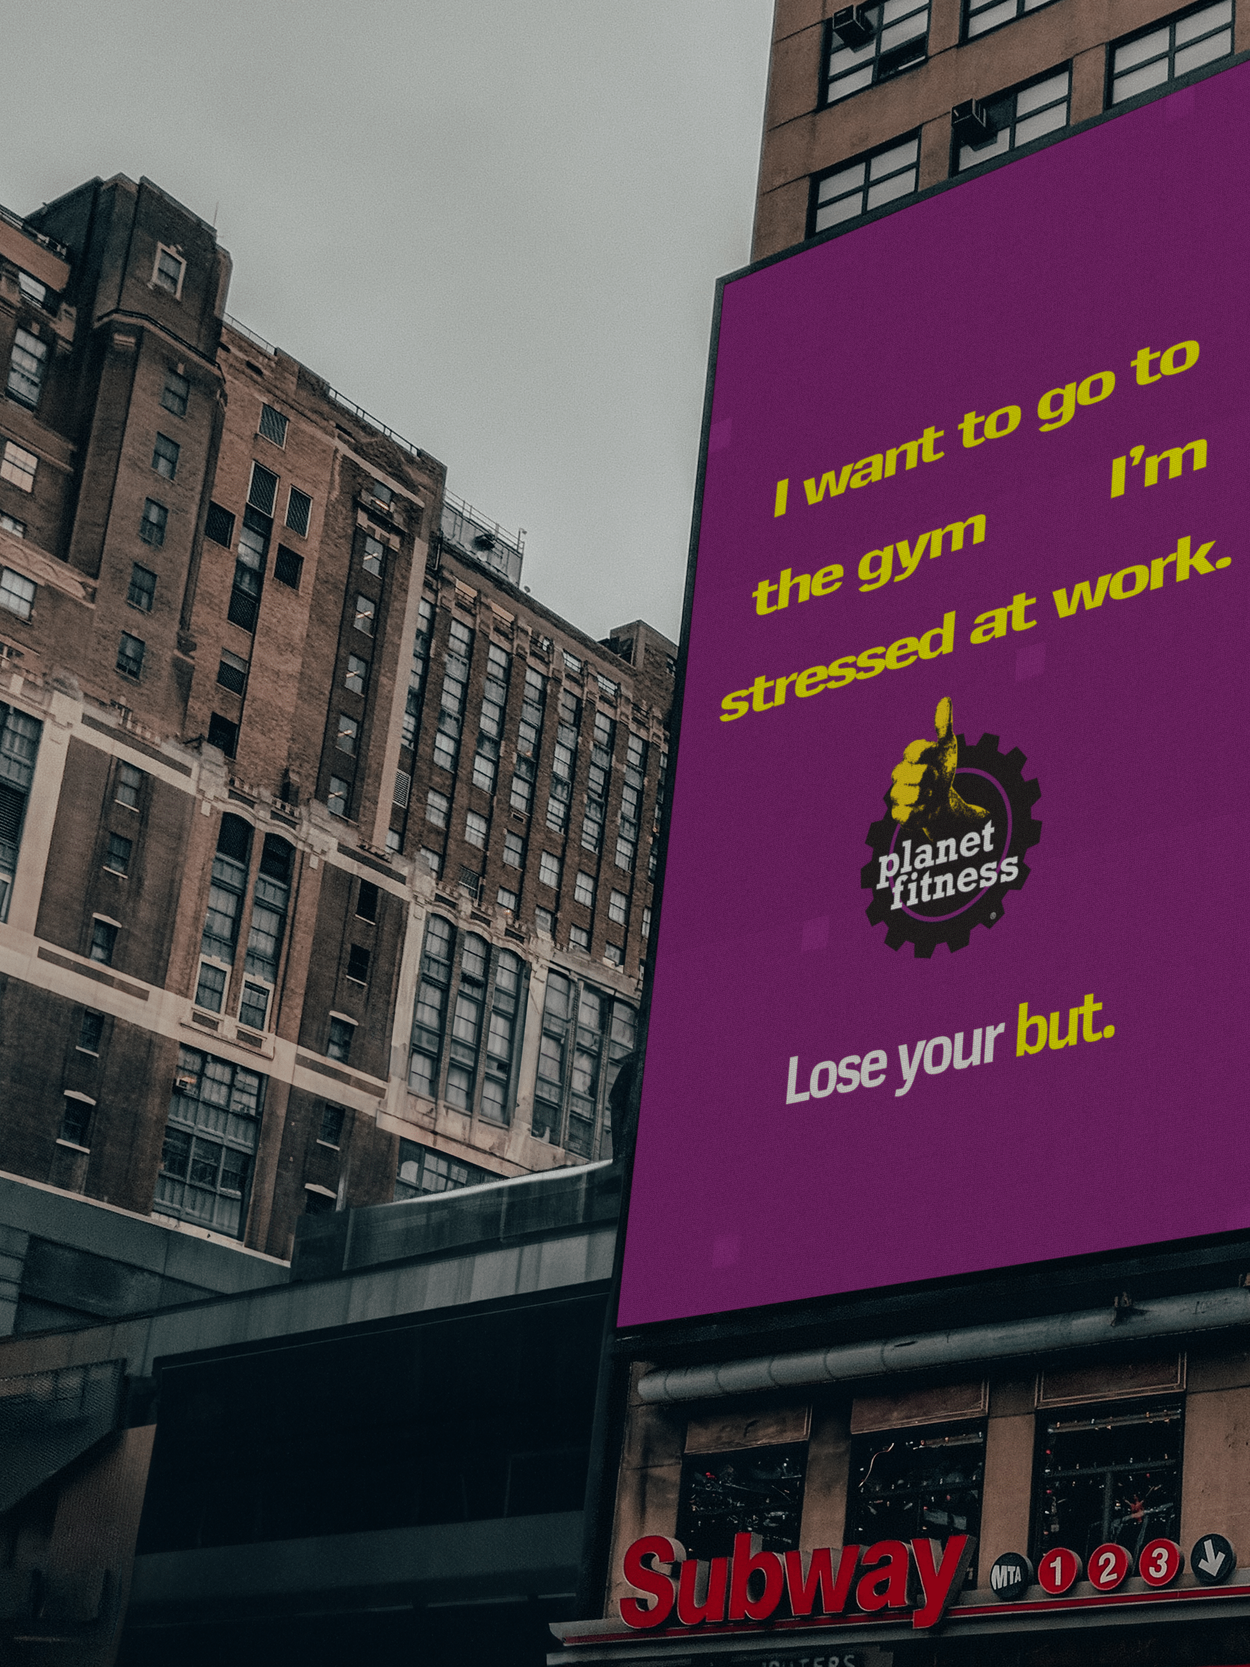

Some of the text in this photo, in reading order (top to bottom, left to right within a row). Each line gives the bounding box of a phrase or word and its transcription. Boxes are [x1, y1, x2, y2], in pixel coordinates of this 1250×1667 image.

[773, 339, 1200, 519] I want to go to
[751, 438, 1208, 616] the gym I’m
[719, 535, 1232, 723] stressed at work.
[875, 819, 995, 890] planet
[890, 855, 1019, 911] fitness
[785, 992, 1116, 1105] Lose your but.
[619, 1531, 1169, 1630] Subway MTA 1 2 3
